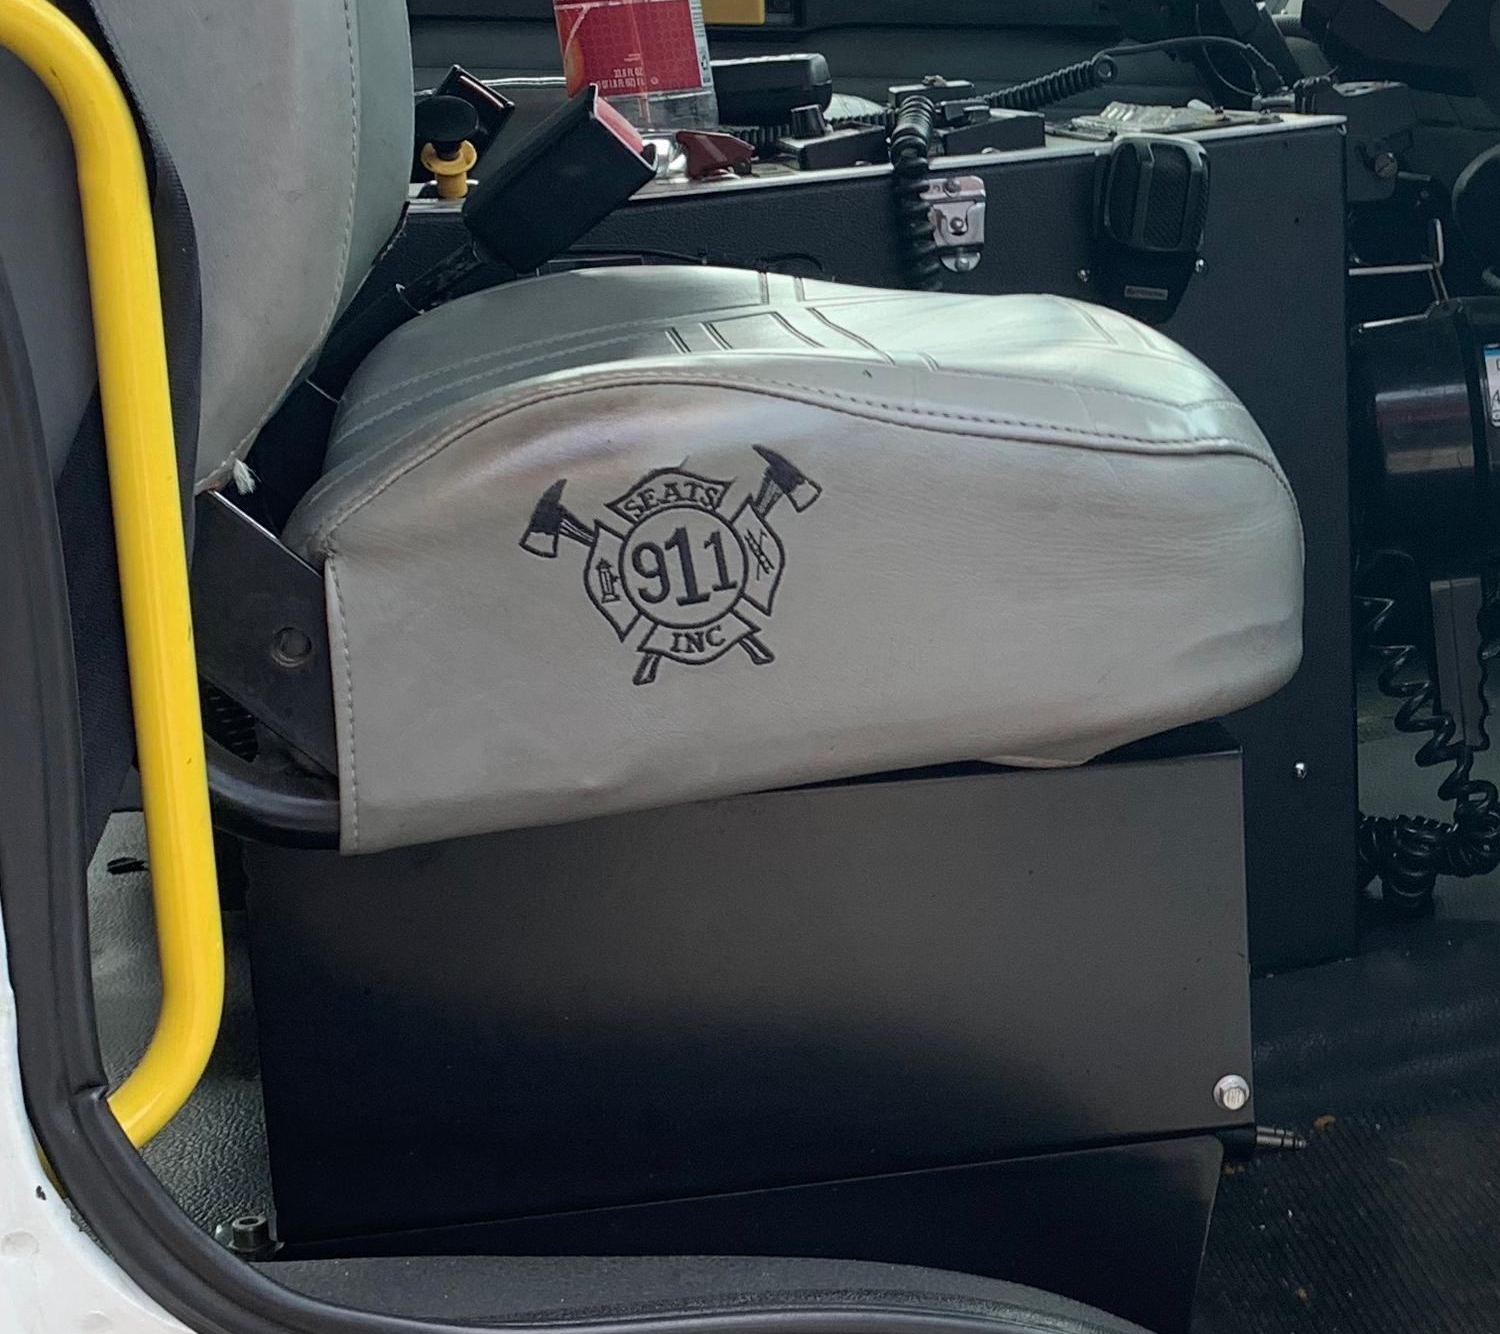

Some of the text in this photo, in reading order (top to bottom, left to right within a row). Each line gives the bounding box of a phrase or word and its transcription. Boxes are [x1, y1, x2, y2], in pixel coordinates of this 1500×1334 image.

[623, 481, 720, 518] SEATS
[631, 526, 738, 607] 911
[670, 625, 727, 654] INC
